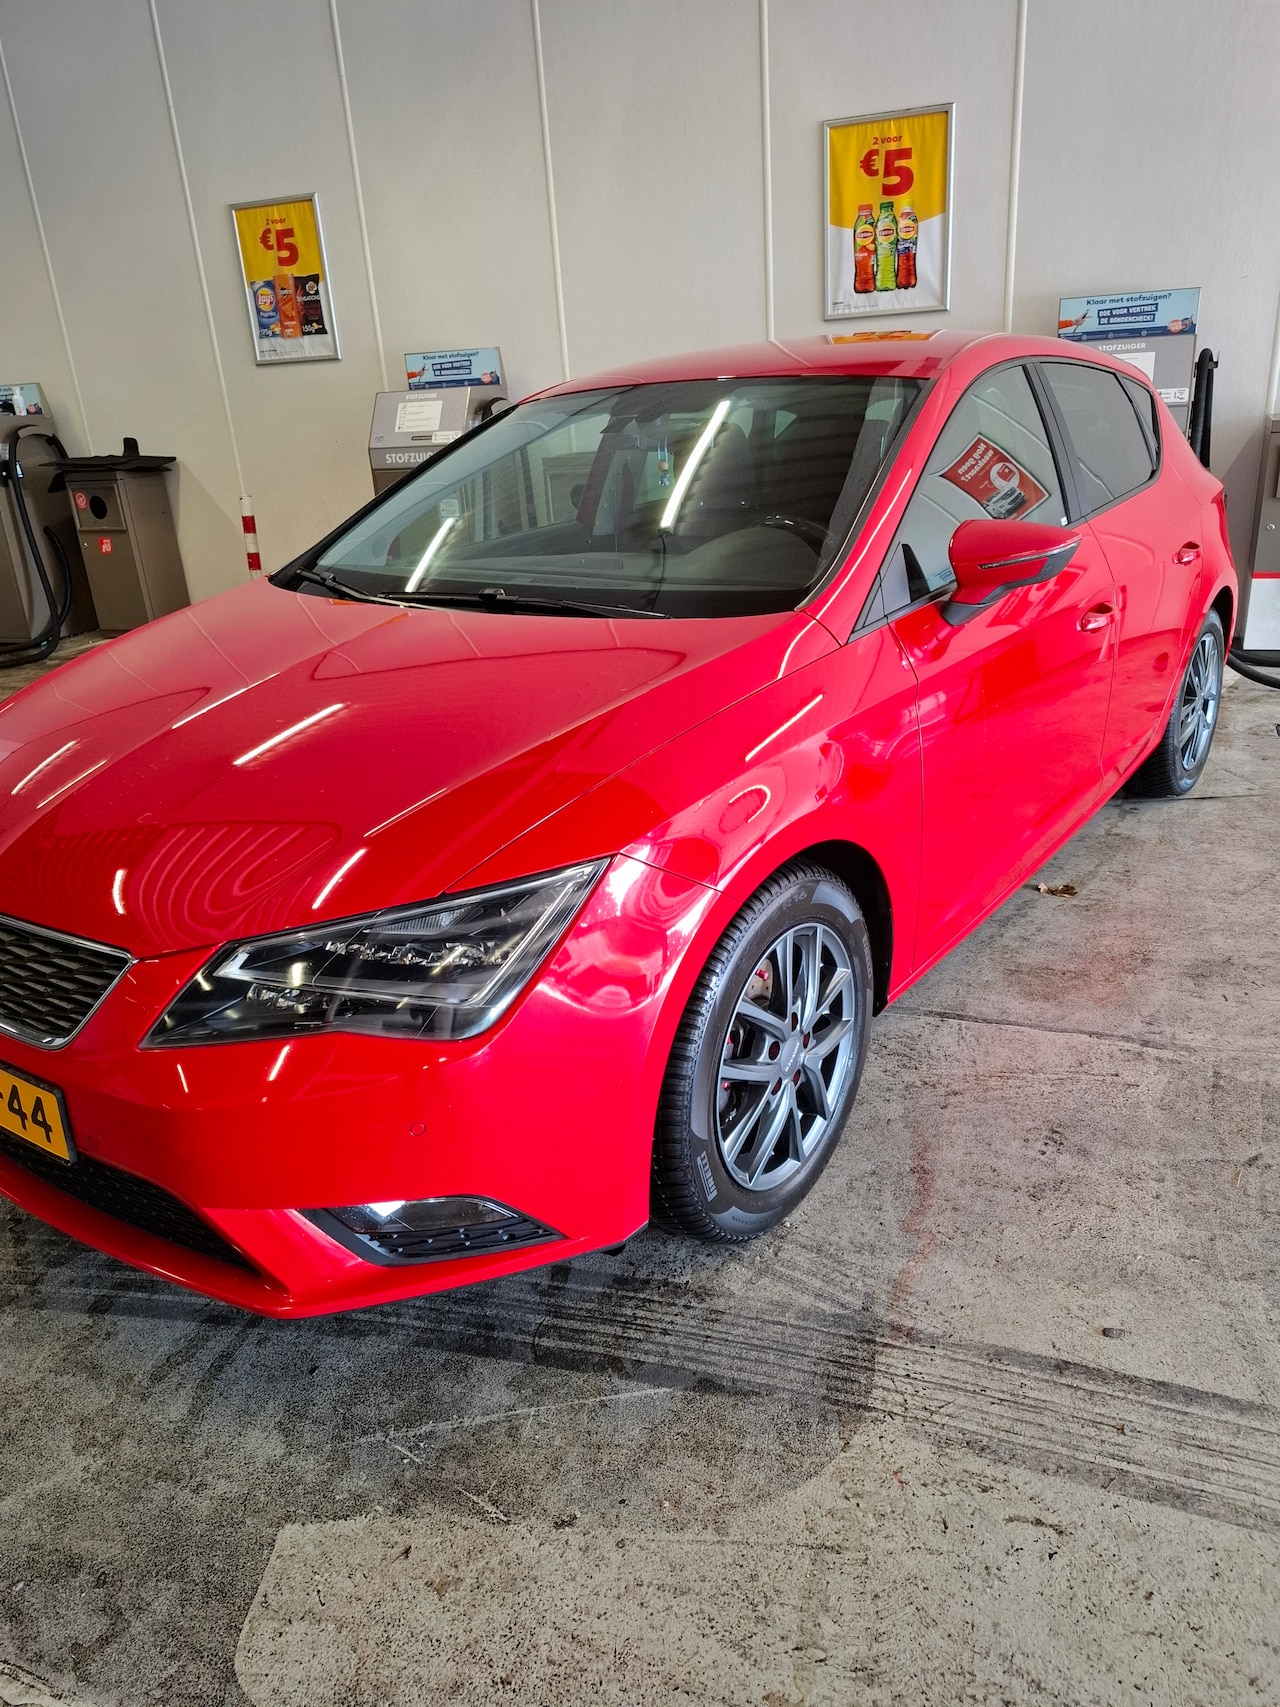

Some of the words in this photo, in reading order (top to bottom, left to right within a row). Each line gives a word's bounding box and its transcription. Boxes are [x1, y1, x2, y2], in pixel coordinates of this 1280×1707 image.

[872, 136, 879, 145] 2
[880, 134, 903, 145] voor
[859, 147, 914, 197] €5
[265, 218, 271, 226] 2
[271, 217, 287, 225] voor
[259, 227, 299, 267] €5
[1126, 292, 1172, 303] stofzuigen?
[1112, 308, 1128, 316] VOOR
[1129, 304, 1157, 313] VERTREK
[1109, 315, 1154, 323] BANDENCHECK!
[1098, 342, 1146, 351] STOFZUIGER
